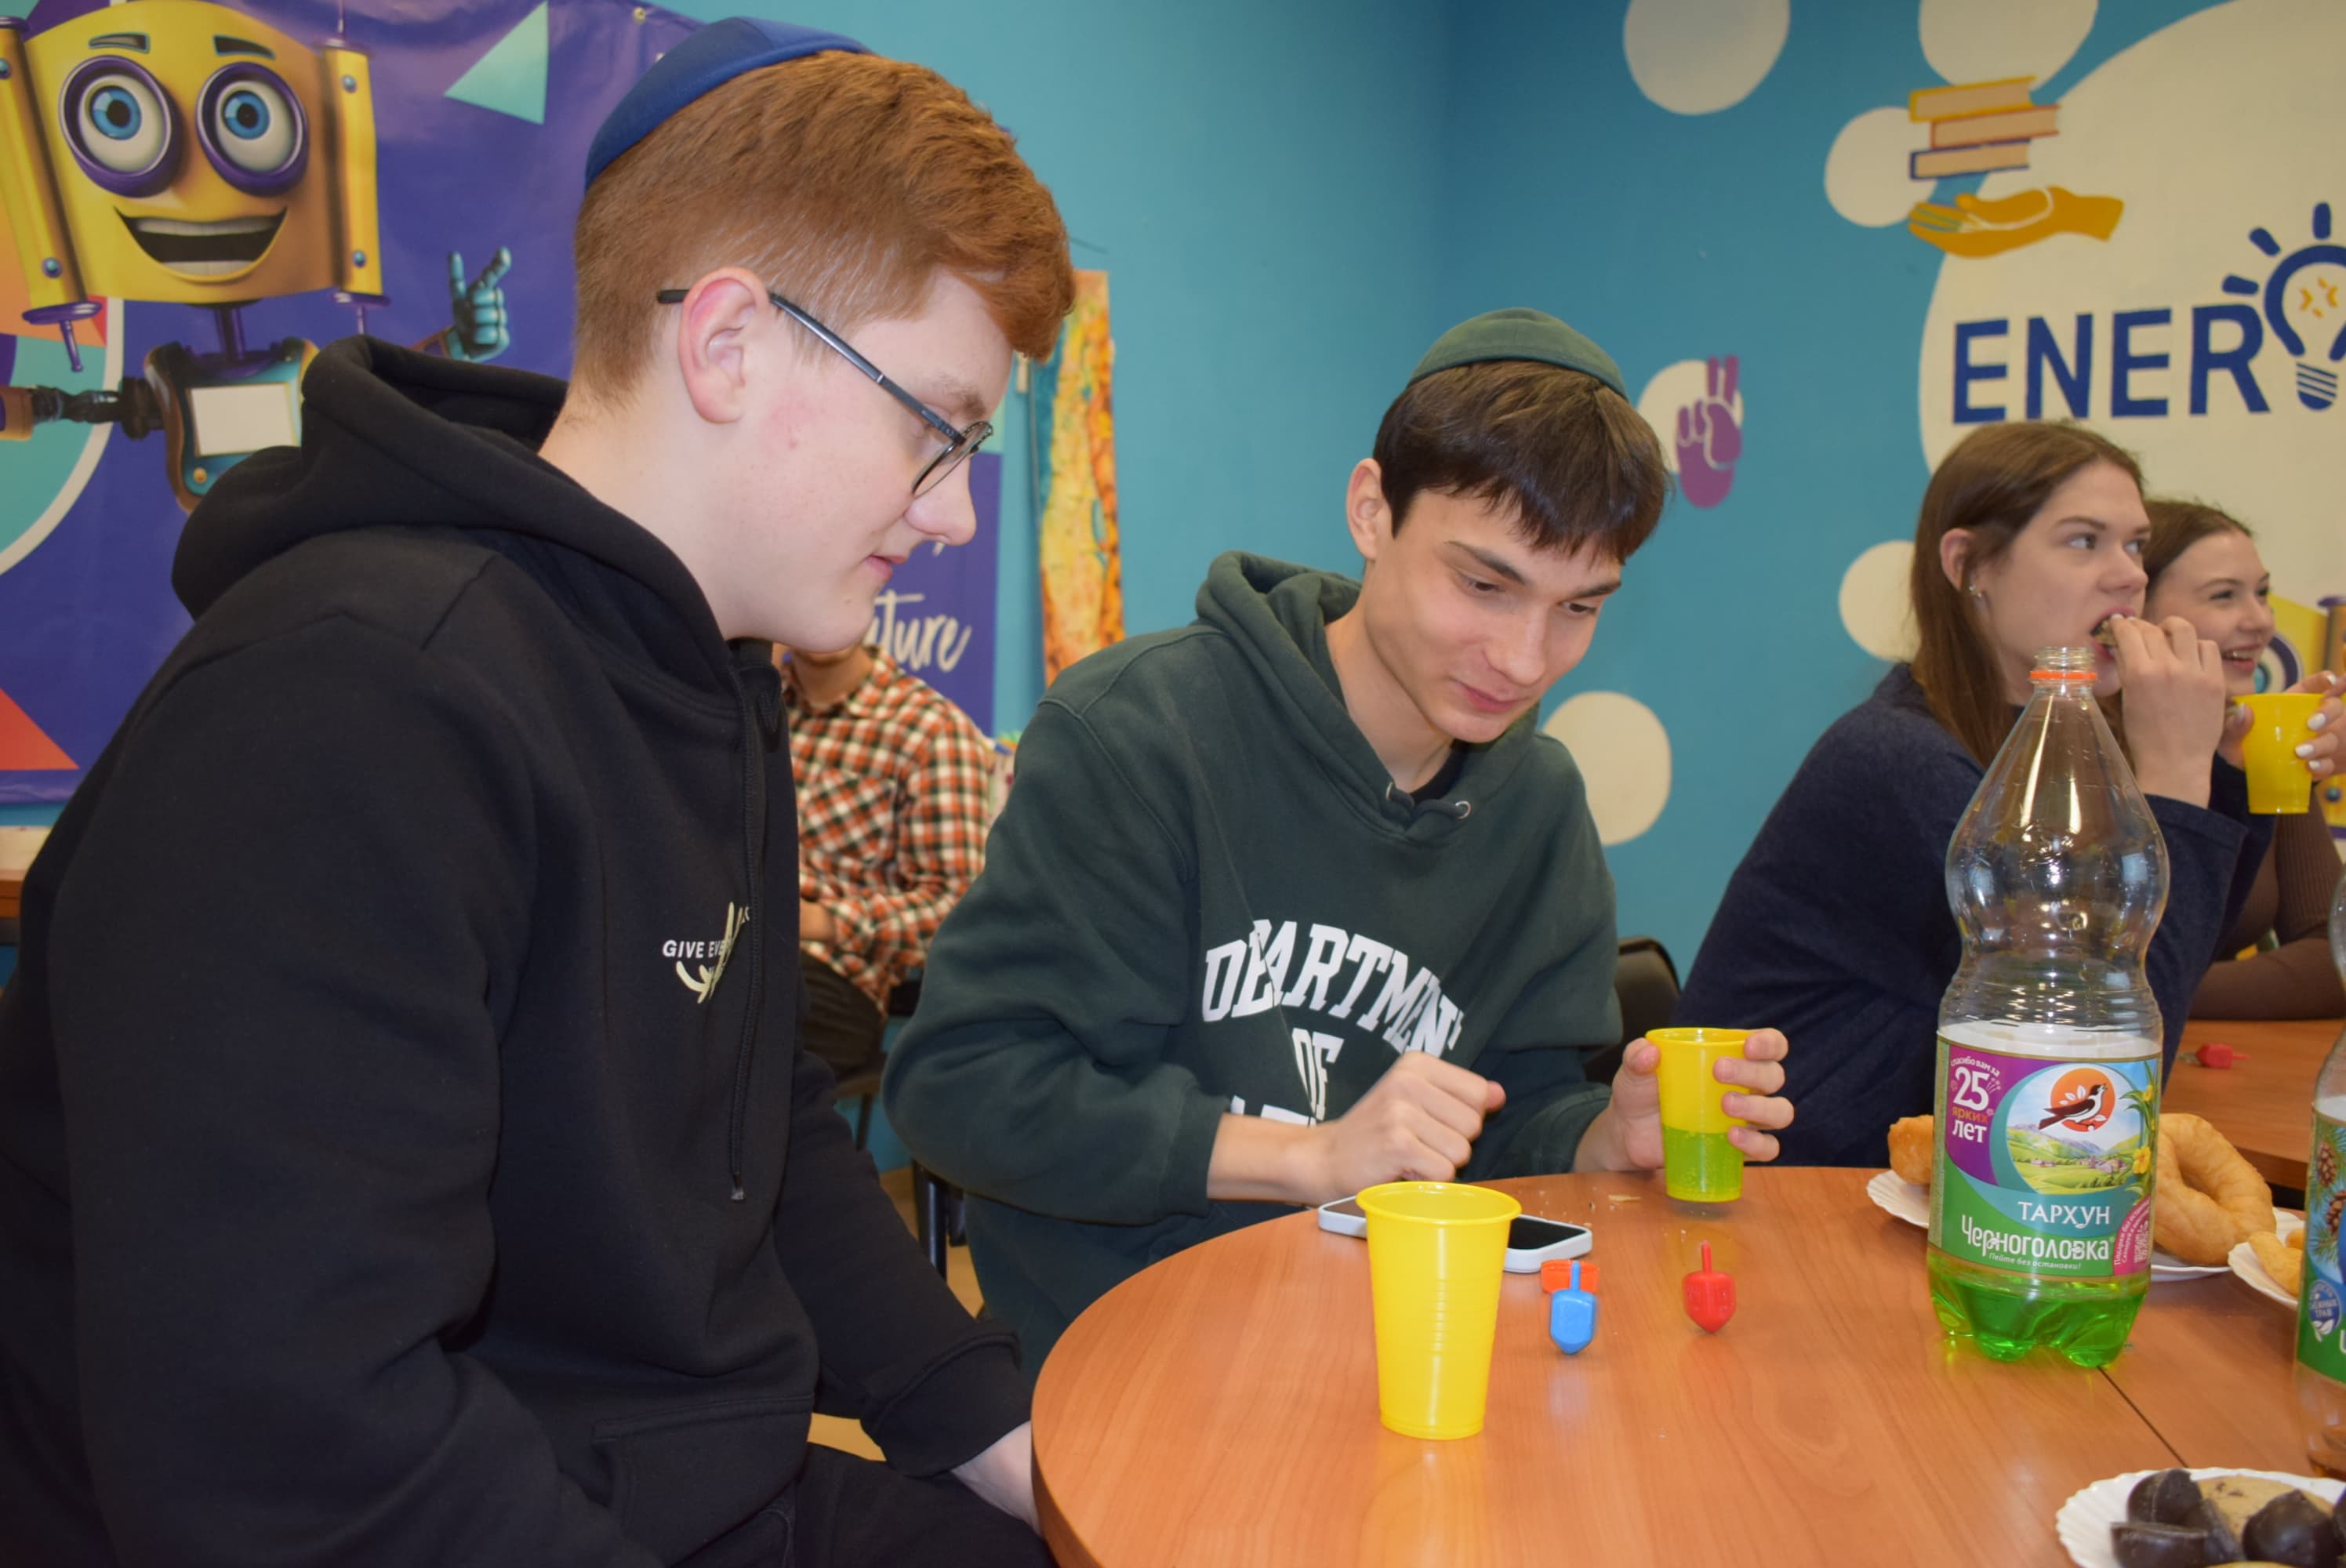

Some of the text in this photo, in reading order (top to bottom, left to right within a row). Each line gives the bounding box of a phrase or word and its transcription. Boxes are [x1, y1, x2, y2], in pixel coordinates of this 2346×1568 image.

[870, 590, 972, 673] ture
[663, 940, 705, 958] GIVE
[1292, 1027, 1345, 1121] OF
[1953, 1066, 1989, 1111] 25
[1952, 1119, 1987, 1143] лет
[2017, 1201, 2110, 1229] ТАРХУН
[1962, 1214, 2110, 1261] Черноголовка
[2017, 1258, 2031, 1266] без
